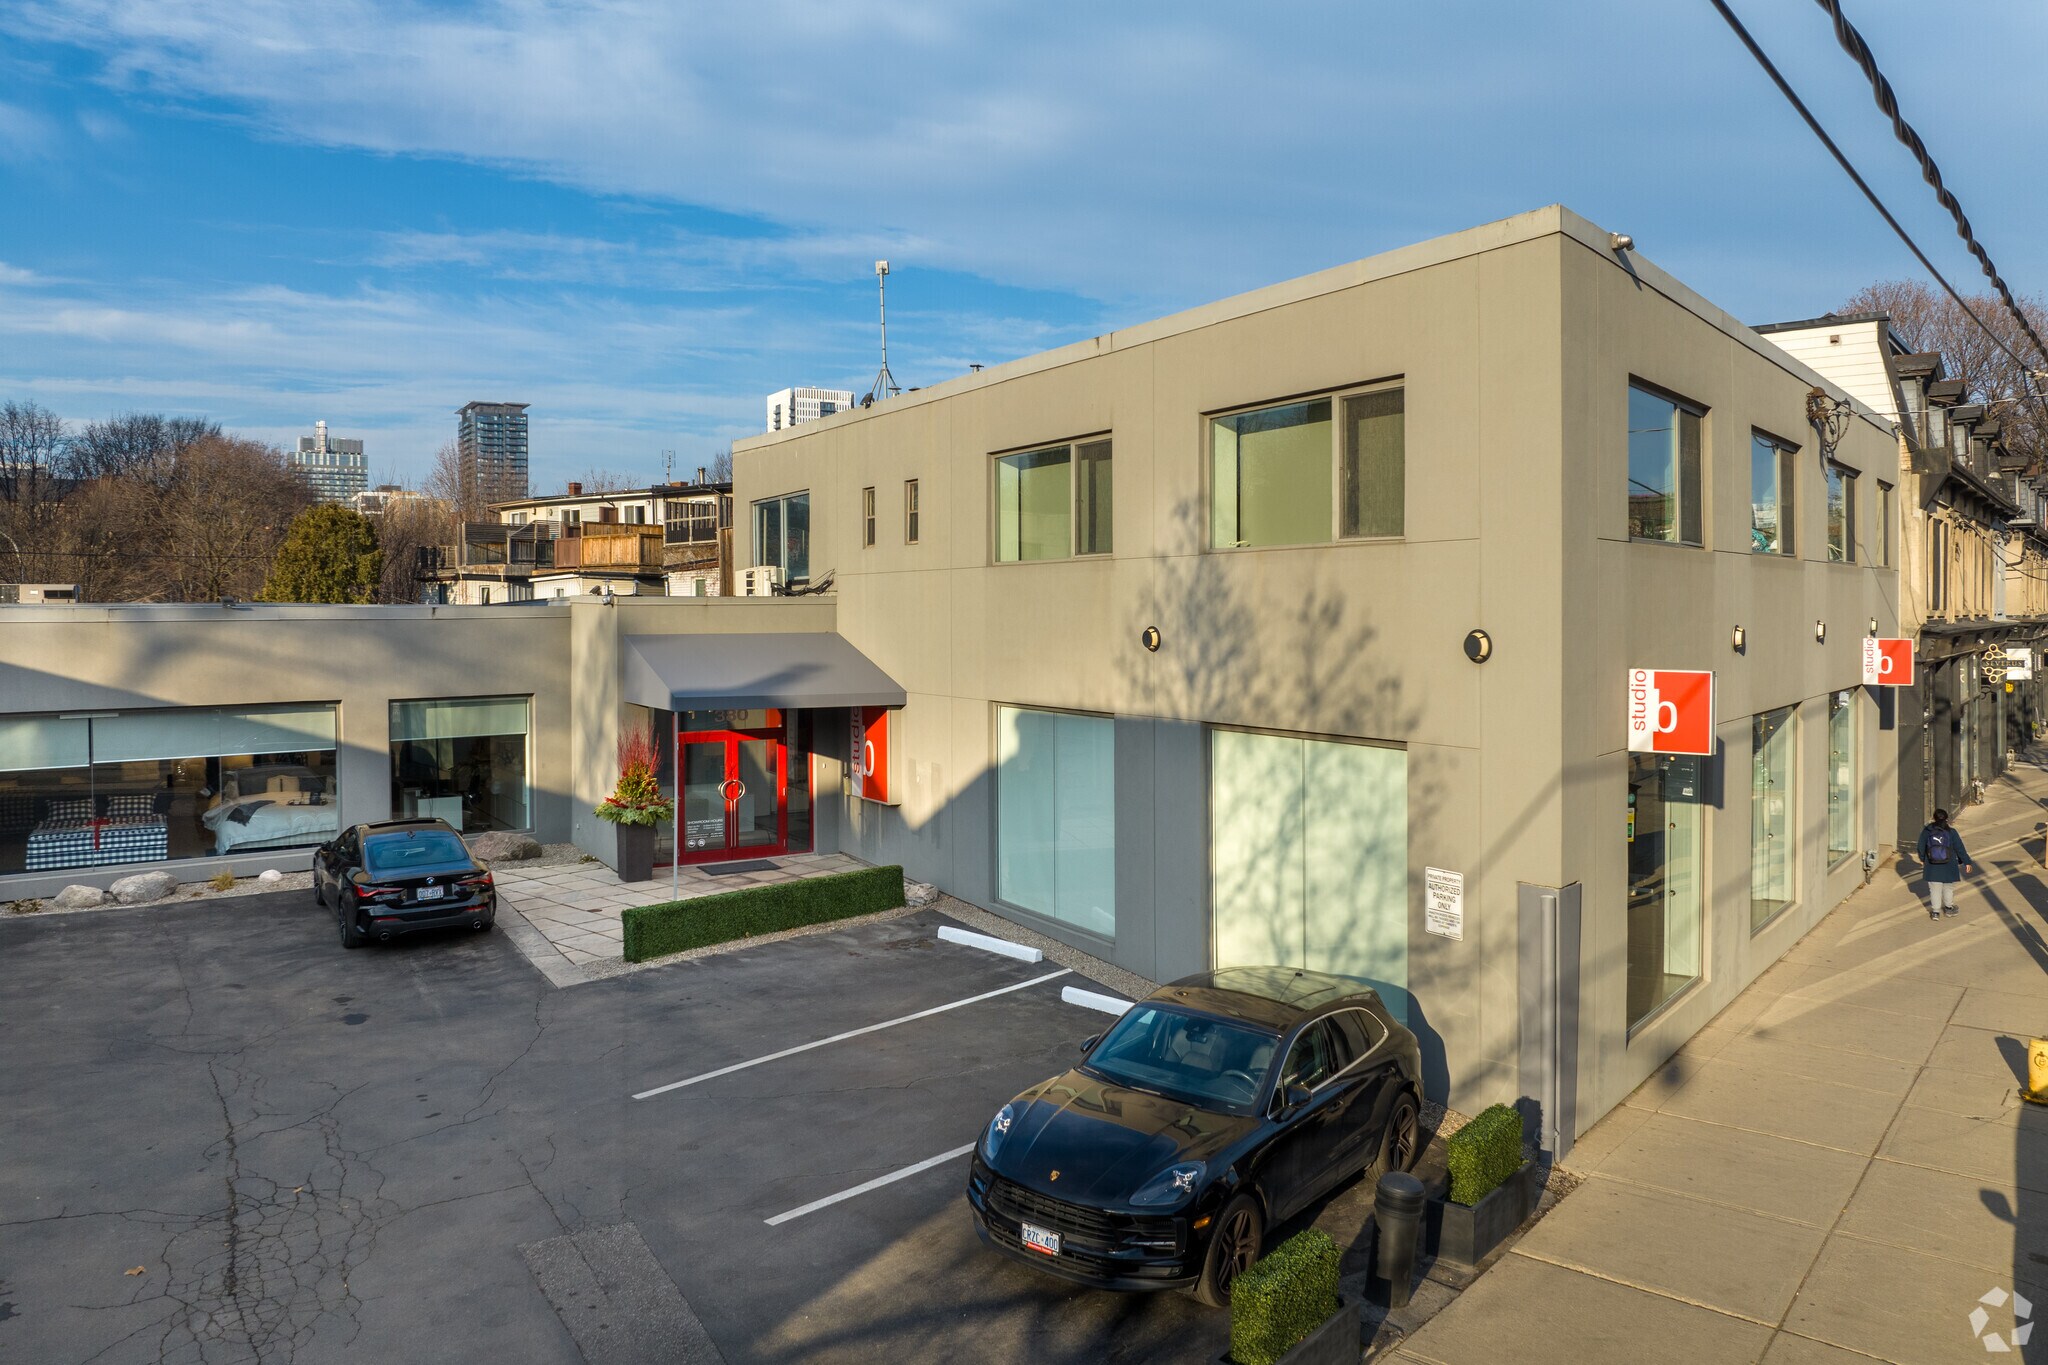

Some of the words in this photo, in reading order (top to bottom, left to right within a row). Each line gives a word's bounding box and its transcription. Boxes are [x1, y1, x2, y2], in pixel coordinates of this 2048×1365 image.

[1864, 638, 1874, 674] studio
[1878, 648, 1893, 674] b
[1631, 670, 1647, 731] studio
[714, 709, 749, 722] 380
[1653, 688, 1678, 734] b
[1428, 883, 1460, 896] AUTHORIZED
[1433, 892, 1456, 903] PARKING
[1437, 901, 1451, 911] ONLY
